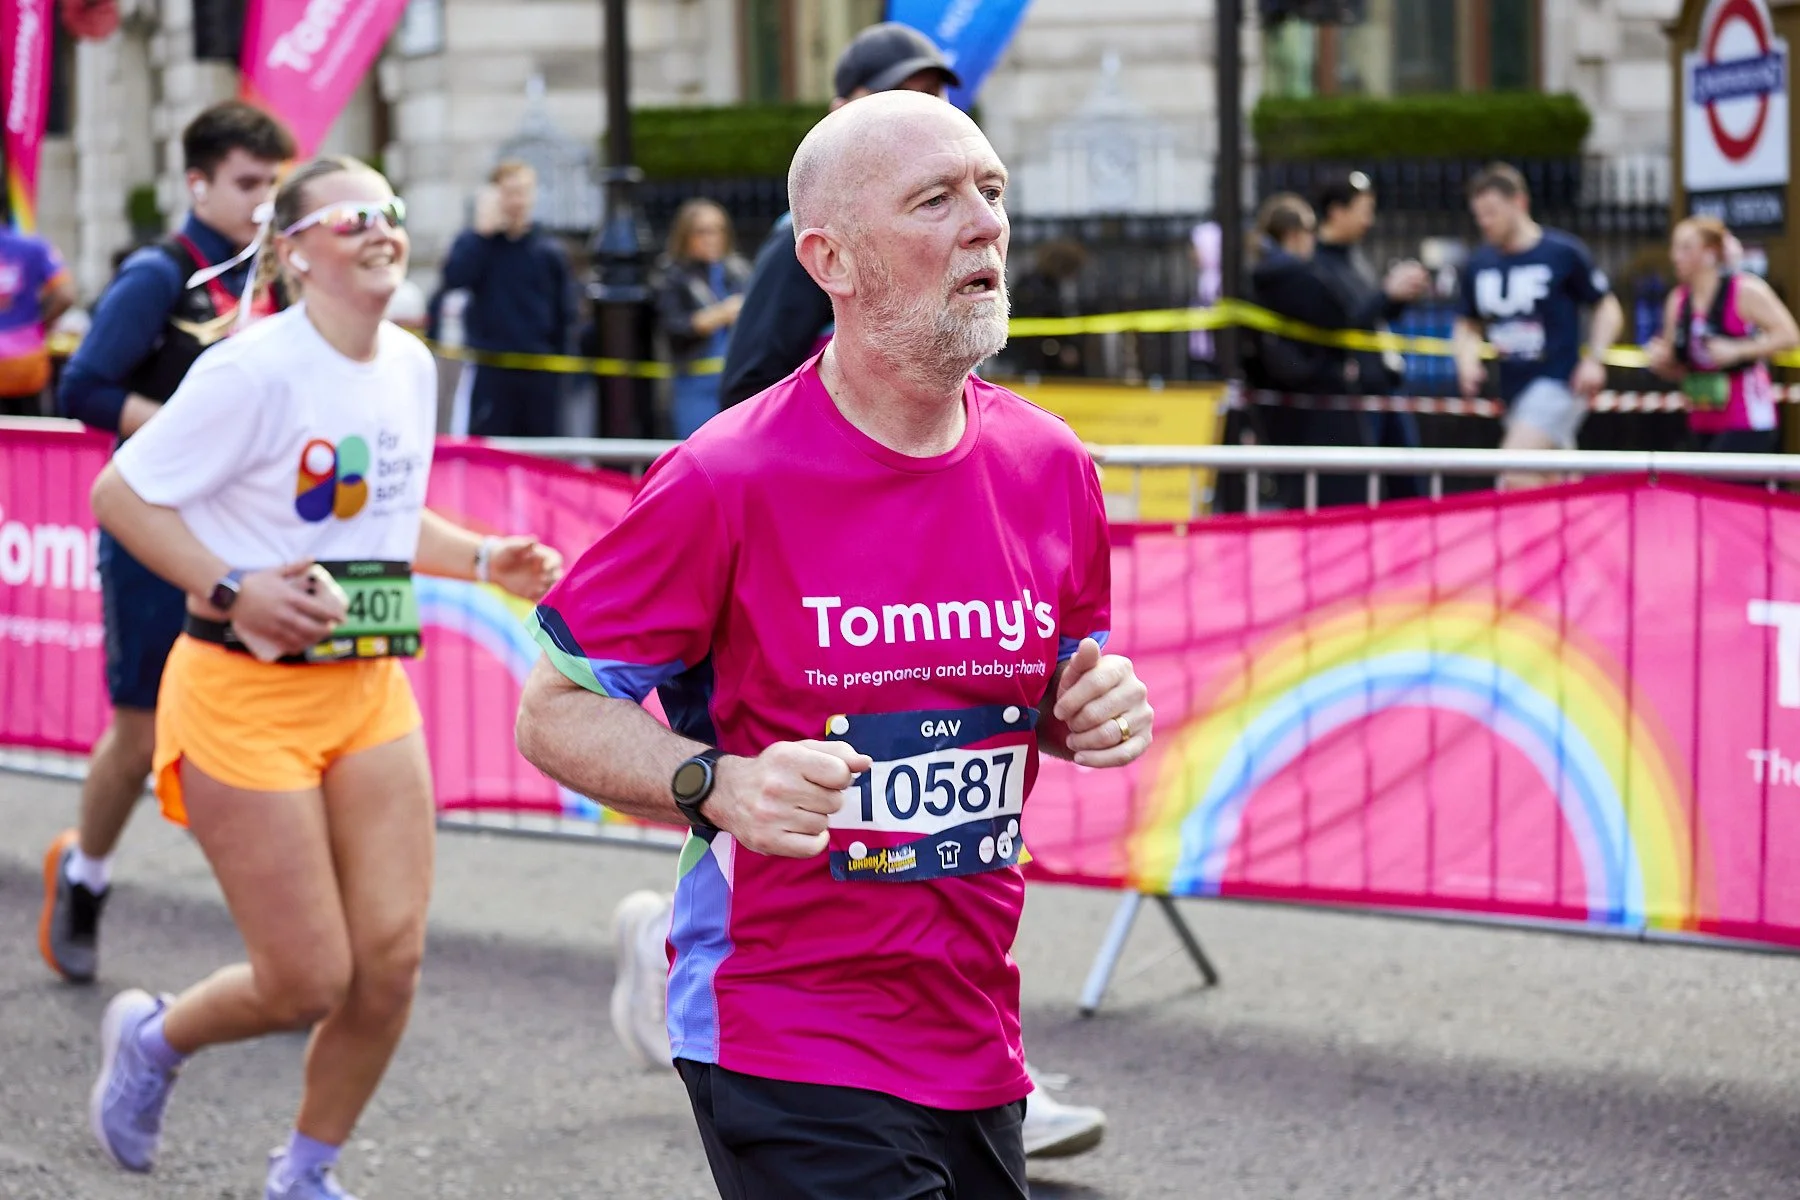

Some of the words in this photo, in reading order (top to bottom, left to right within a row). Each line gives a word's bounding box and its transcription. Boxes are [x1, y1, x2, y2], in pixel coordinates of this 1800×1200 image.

[0, 519, 102, 592] om
[347, 590, 403, 623] 407
[802, 589, 1056, 651] Tommy's
[805, 669, 838, 686] The
[843, 667, 931, 689] pregnancy
[935, 660, 967, 677] and
[971, 659, 1014, 678] baby
[920, 719, 962, 738] GAV
[1747, 748, 1800, 787] Th
[852, 752, 1014, 822] 10587
[848, 855, 879, 872] LONDON
